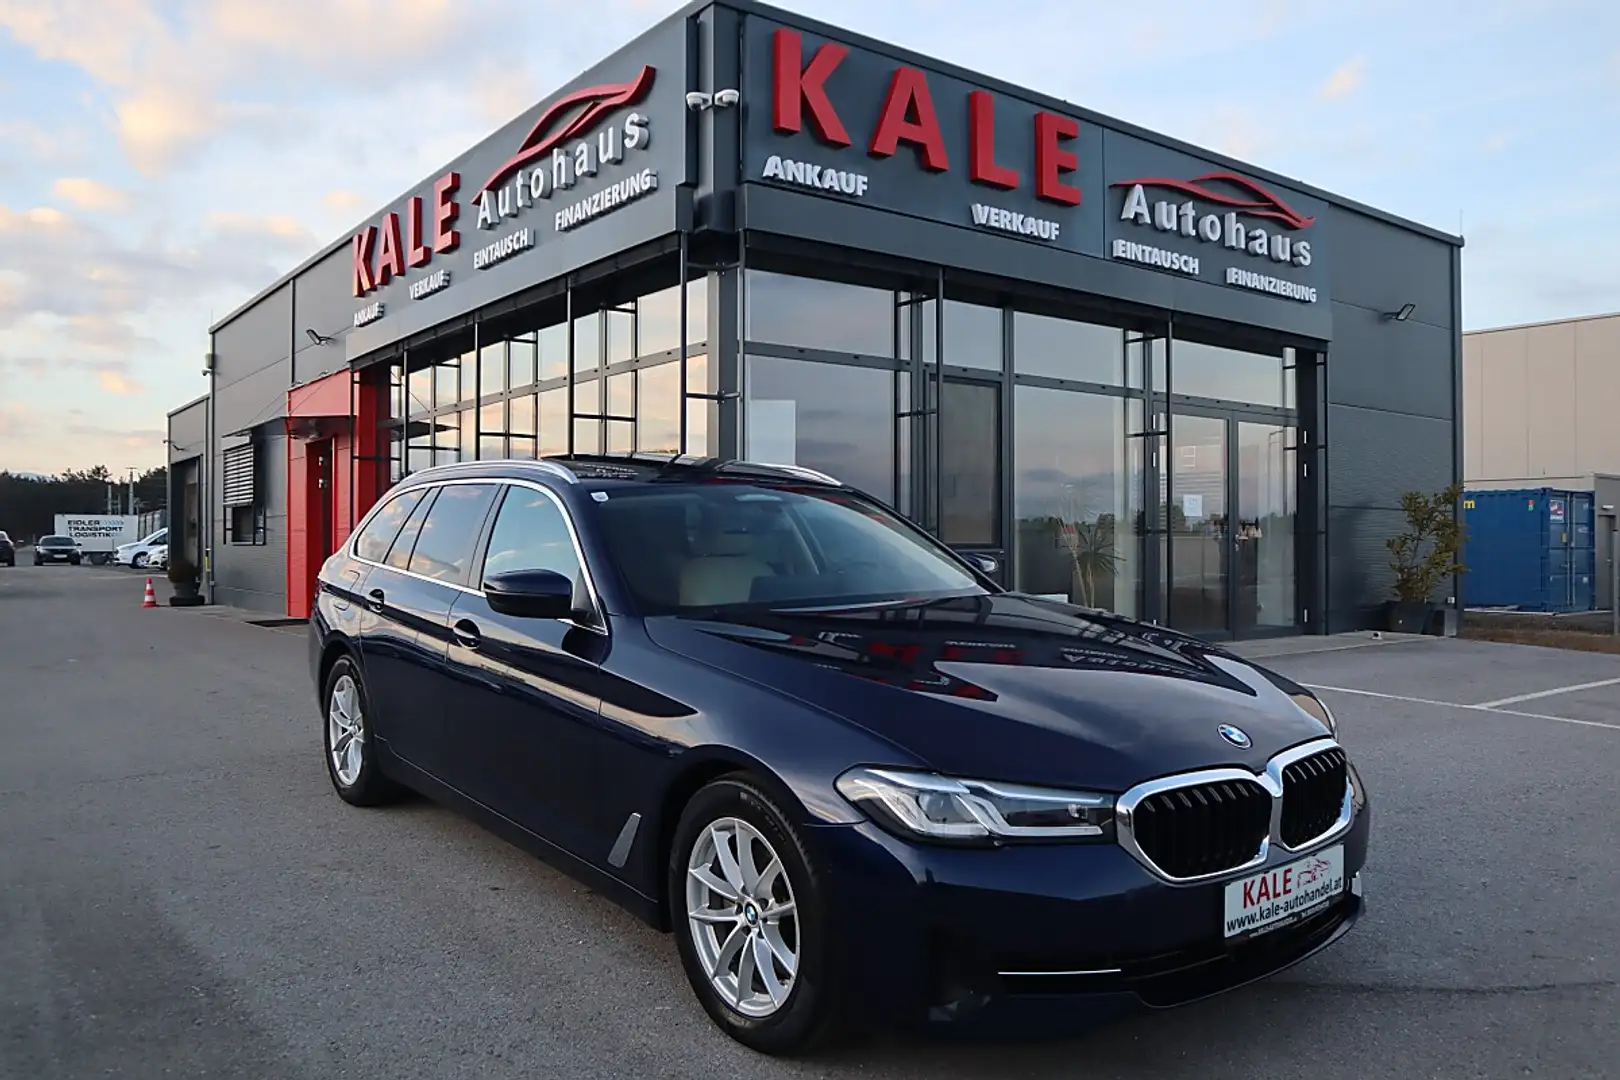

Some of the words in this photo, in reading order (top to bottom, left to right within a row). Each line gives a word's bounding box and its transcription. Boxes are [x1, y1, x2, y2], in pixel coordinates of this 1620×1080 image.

[773, 27, 1082, 206] KALE
[476, 112, 650, 231] Autohaus
[762, 155, 868, 197] ANKAUF
[555, 167, 658, 232] FINANZIERUNG
[352, 172, 461, 298] KALE
[970, 203, 1060, 241] VERKAUF
[1121, 183, 1312, 267] Autohaus
[474, 227, 534, 270] EINTAUSCH
[1112, 239, 1199, 275] EINTAUSCH
[409, 268, 451, 301] VERKAUF
[1226, 267, 1317, 303] FINANZIERUNG
[1226, 876, 1342, 933] www.kale-autohandel.at
[1243, 867, 1293, 909] KALE
